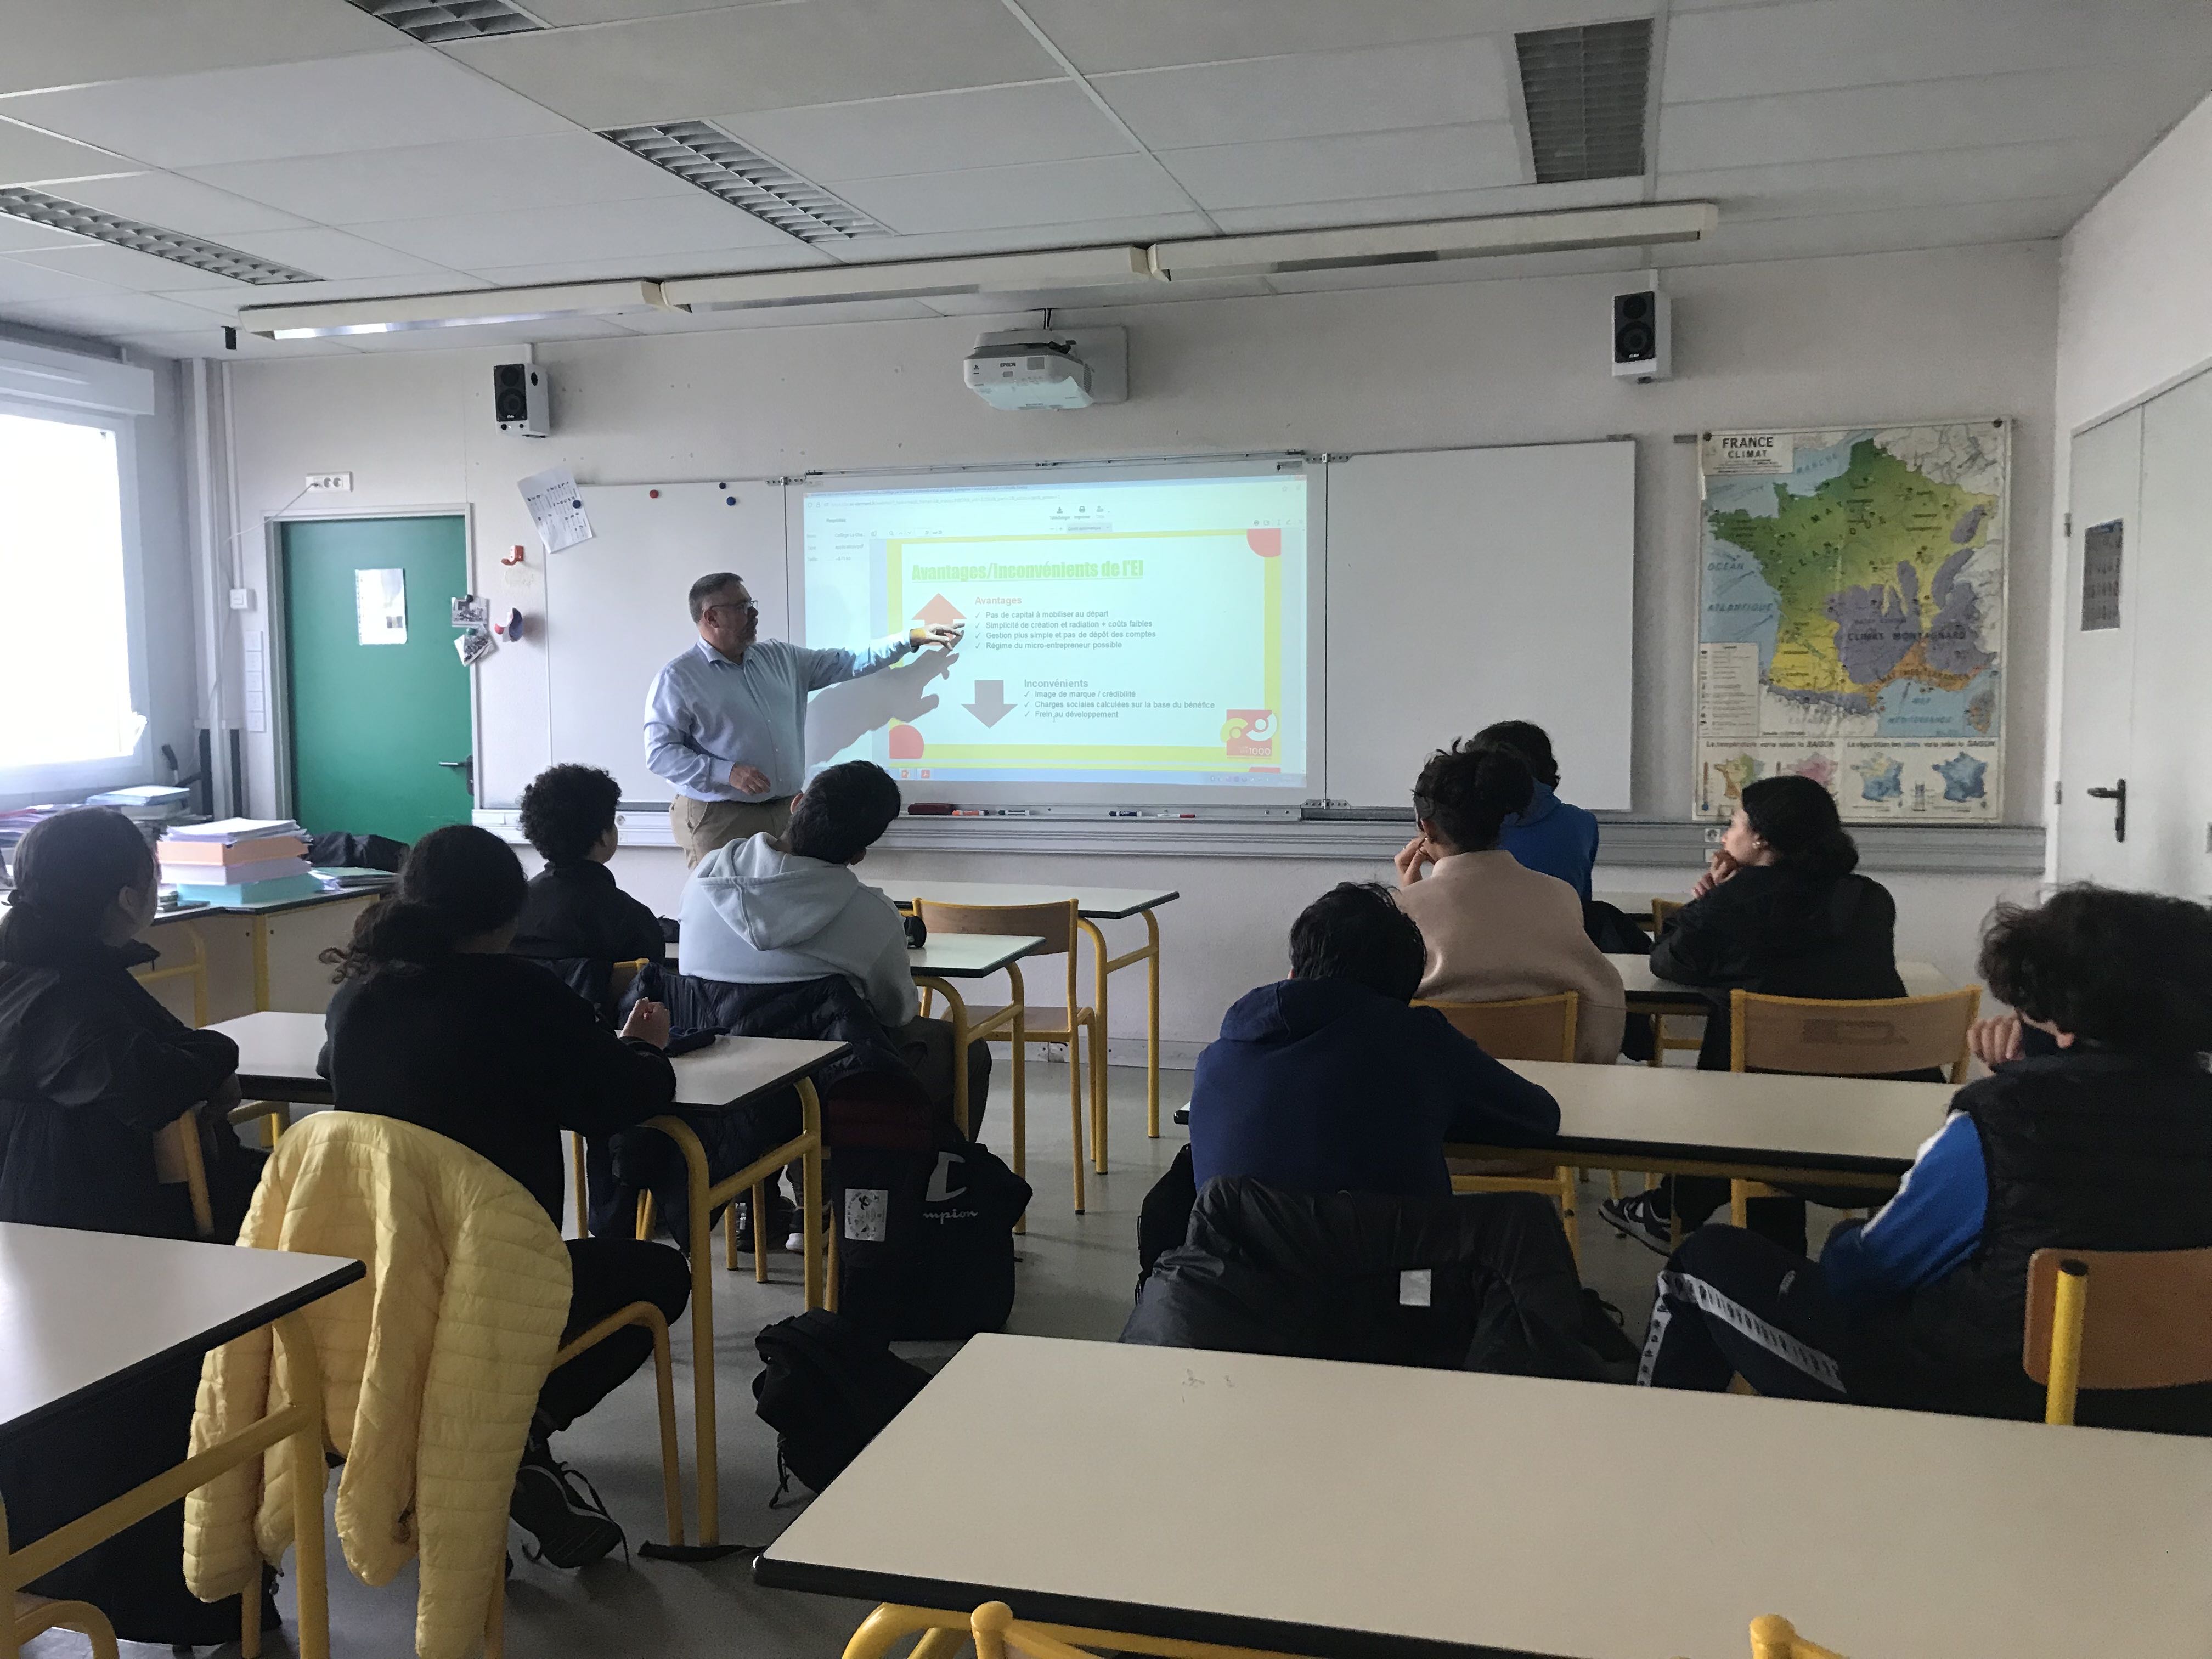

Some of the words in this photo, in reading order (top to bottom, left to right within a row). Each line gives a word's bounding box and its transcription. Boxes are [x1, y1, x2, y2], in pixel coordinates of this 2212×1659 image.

[1722, 437, 1774, 448] FRANCE
[1728, 450, 1768, 458] CLIMAT
[912, 561, 1098, 581] Avantages/Inconvénients
[1101, 561, 1120, 577] de
[1122, 560, 1143, 576] l'EI
[975, 597, 1022, 606] Avantages
[1012, 611, 1034, 619] capital
[1086, 610, 1108, 619] départ
[986, 622, 1019, 630] Simplicité
[1014, 631, 1028, 640] plus
[1030, 631, 1053, 640] simple
[1089, 631, 1109, 640] dépôt
[986, 641, 1012, 650] Régime
[1025, 641, 1090, 650] micro-entrepreneur
[1093, 641, 1122, 650] possible
[1024, 679, 1088, 687] Inconvénients
[1035, 691, 1056, 699] Image
[1035, 701, 1064, 709] Charges
[1184, 701, 1215, 709] bénéfice
[1065, 710, 1119, 719] développement
[923, 1209, 978, 1225] mpion
